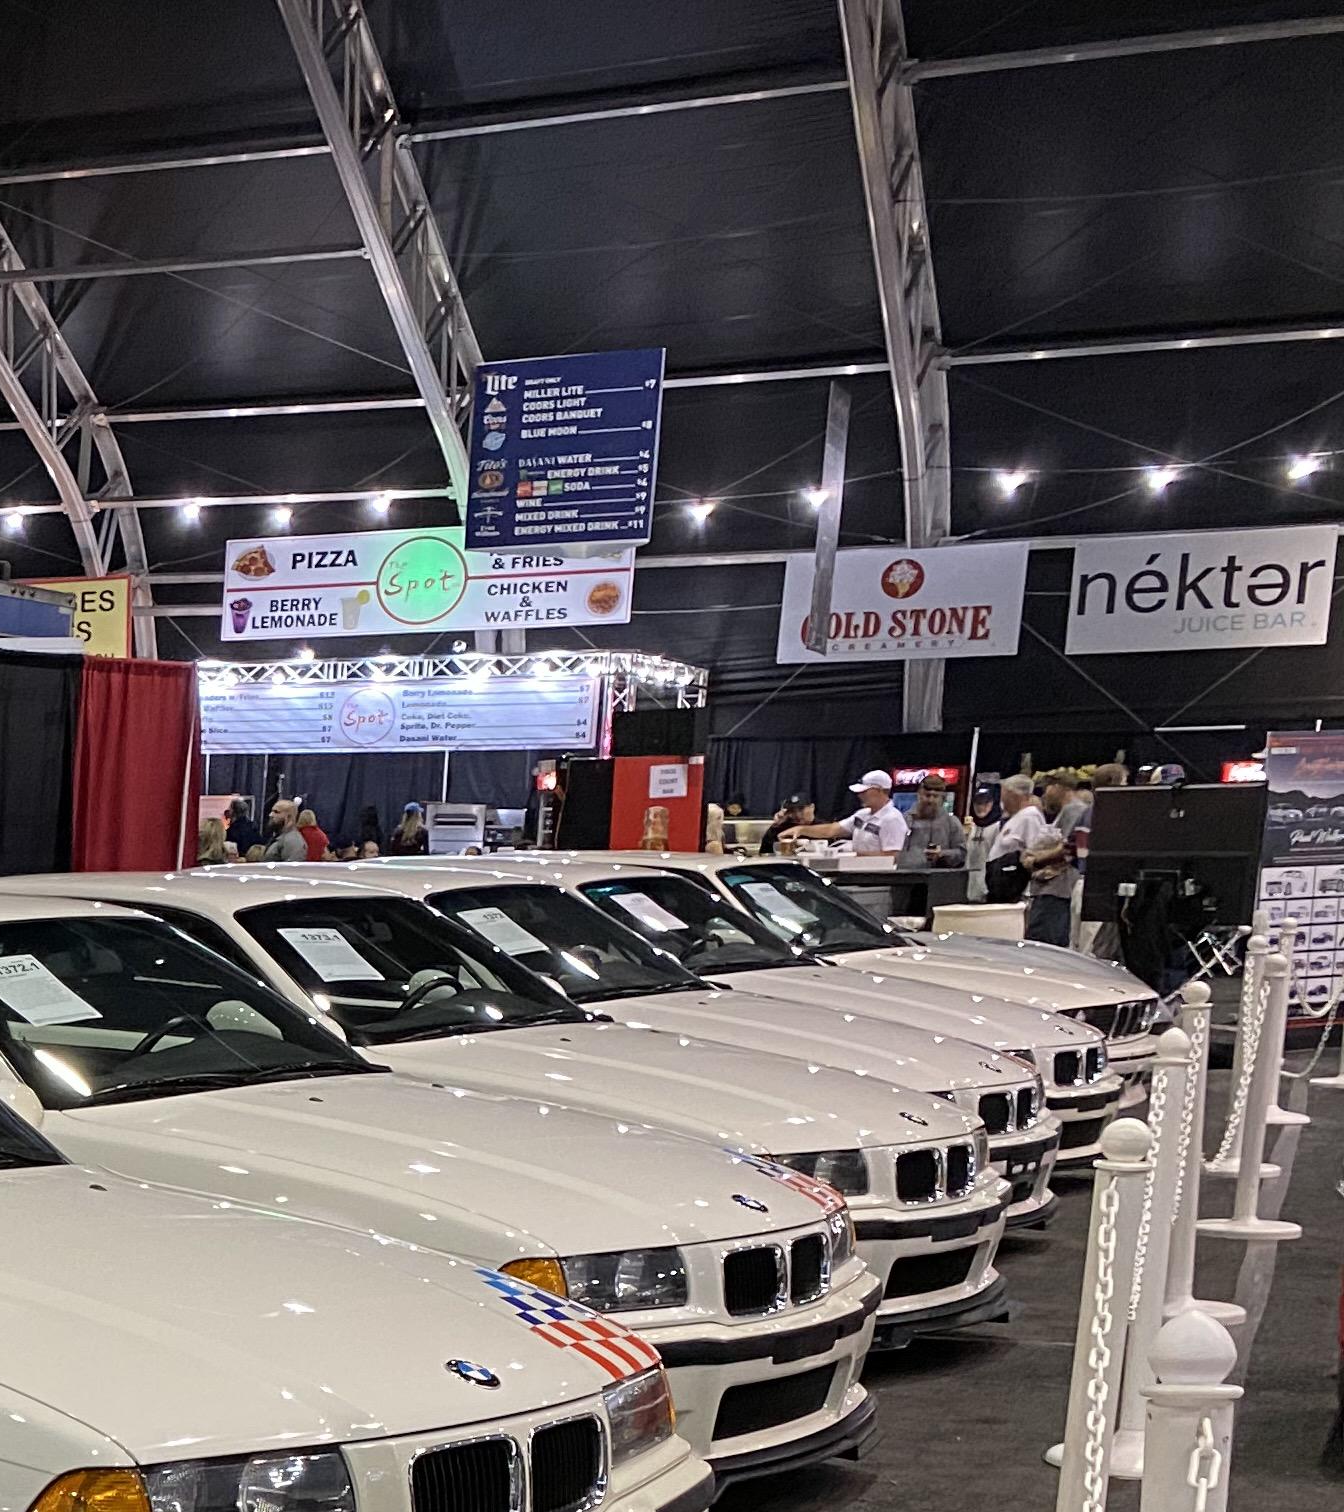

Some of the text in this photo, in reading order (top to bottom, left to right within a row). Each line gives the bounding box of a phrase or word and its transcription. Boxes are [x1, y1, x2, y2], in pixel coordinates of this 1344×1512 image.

[485, 374, 518, 395] Lite
[523, 387, 560, 399] MILLER
[561, 385, 584, 396] LITE
[523, 397, 587, 411] COORS LIGHT
[522, 412, 554, 423] COORS
[520, 427, 546, 439] BLUE
[547, 425, 577, 436] MOON
[556, 453, 592, 464] WATER
[547, 468, 587, 479] ENERGY
[587, 465, 619, 476] DRINK
[564, 481, 591, 492] SODA
[516, 498, 543, 508] WINE
[515, 511, 546, 522] MIXED
[547, 509, 578, 520] DRINK
[514, 525, 553, 536] ENERGY
[553, 523, 586, 533] MIXED
[587, 519, 619, 531] DRINK
[291, 550, 358, 570] PIZZA
[492, 556, 564, 569] & FRIES
[384, 568, 455, 601] Spot
[487, 580, 568, 596] CHICKEN
[74, 590, 115, 612] ES
[269, 597, 323, 613] BERRY
[519, 596, 533, 607] &
[251, 612, 338, 630] LEMONADE
[484, 608, 568, 623] WAFFLES
[1173, 611, 1307, 633] JUICE BAR
[801, 605, 992, 650] OLD STONE
[831, 639, 955, 651] CREAMERY
[344, 710, 389, 733] Spot
